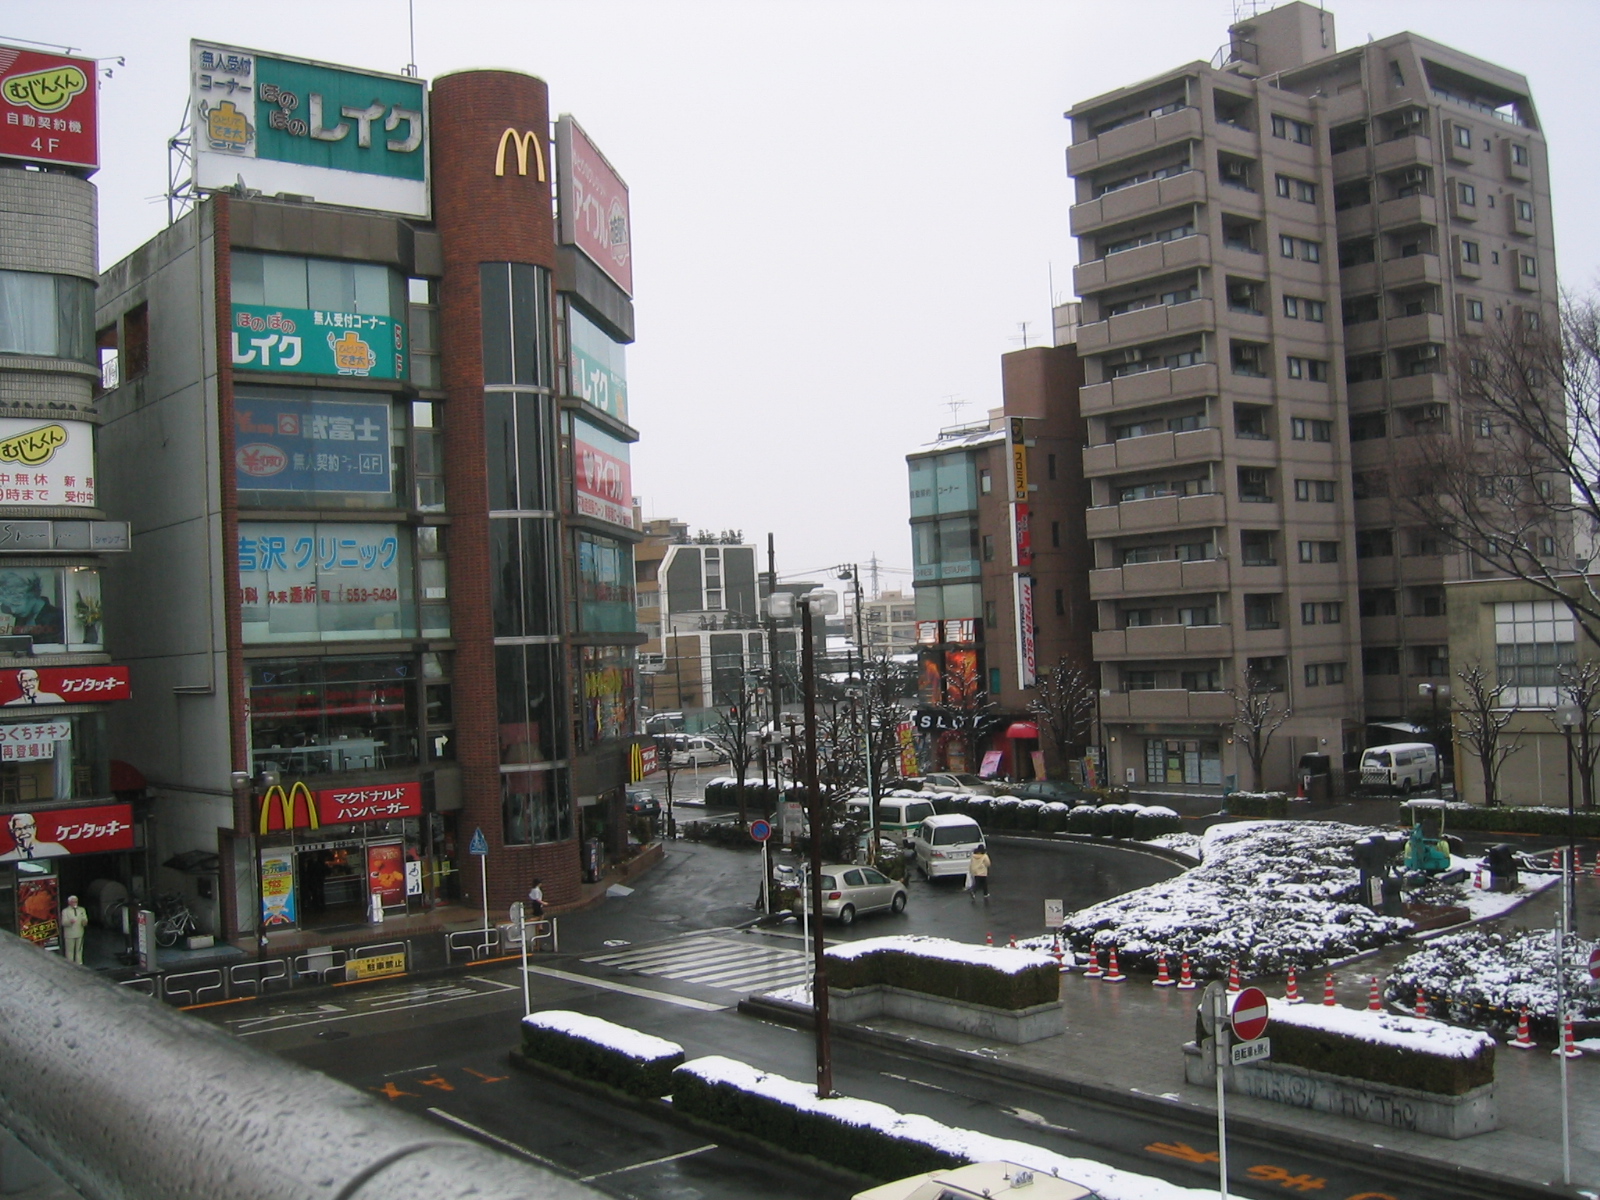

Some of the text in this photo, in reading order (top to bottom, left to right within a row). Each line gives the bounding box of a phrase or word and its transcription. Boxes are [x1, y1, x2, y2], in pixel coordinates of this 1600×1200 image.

[201, 51, 251, 76] 無人受付
[9, 73, 79, 106] むじんくん
[201, 74, 251, 94] コーナー
[7, 112, 82, 133] 自動契約機
[309, 93, 421, 152] レイク
[31, 137, 60, 153] 4F
[313, 311, 387, 330] 無人受付コーナー
[232, 332, 302, 367] レイク
[581, 358, 608, 412] レイク
[303, 414, 380, 441] 武富士
[2, 431, 63, 462] むじんくん
[362, 457, 380, 470] 4F
[239, 536, 398, 571] 吉沢クリニック
[1023, 583, 1036, 678] HYPER SLOT
[62, 677, 125, 693] ケンタッキー
[3, 743, 52, 759] 再登場!!
[333, 787, 405, 804] マクドナルド
[337, 803, 410, 819] ハンバーガー
[56, 820, 130, 841] ケンタッキー
